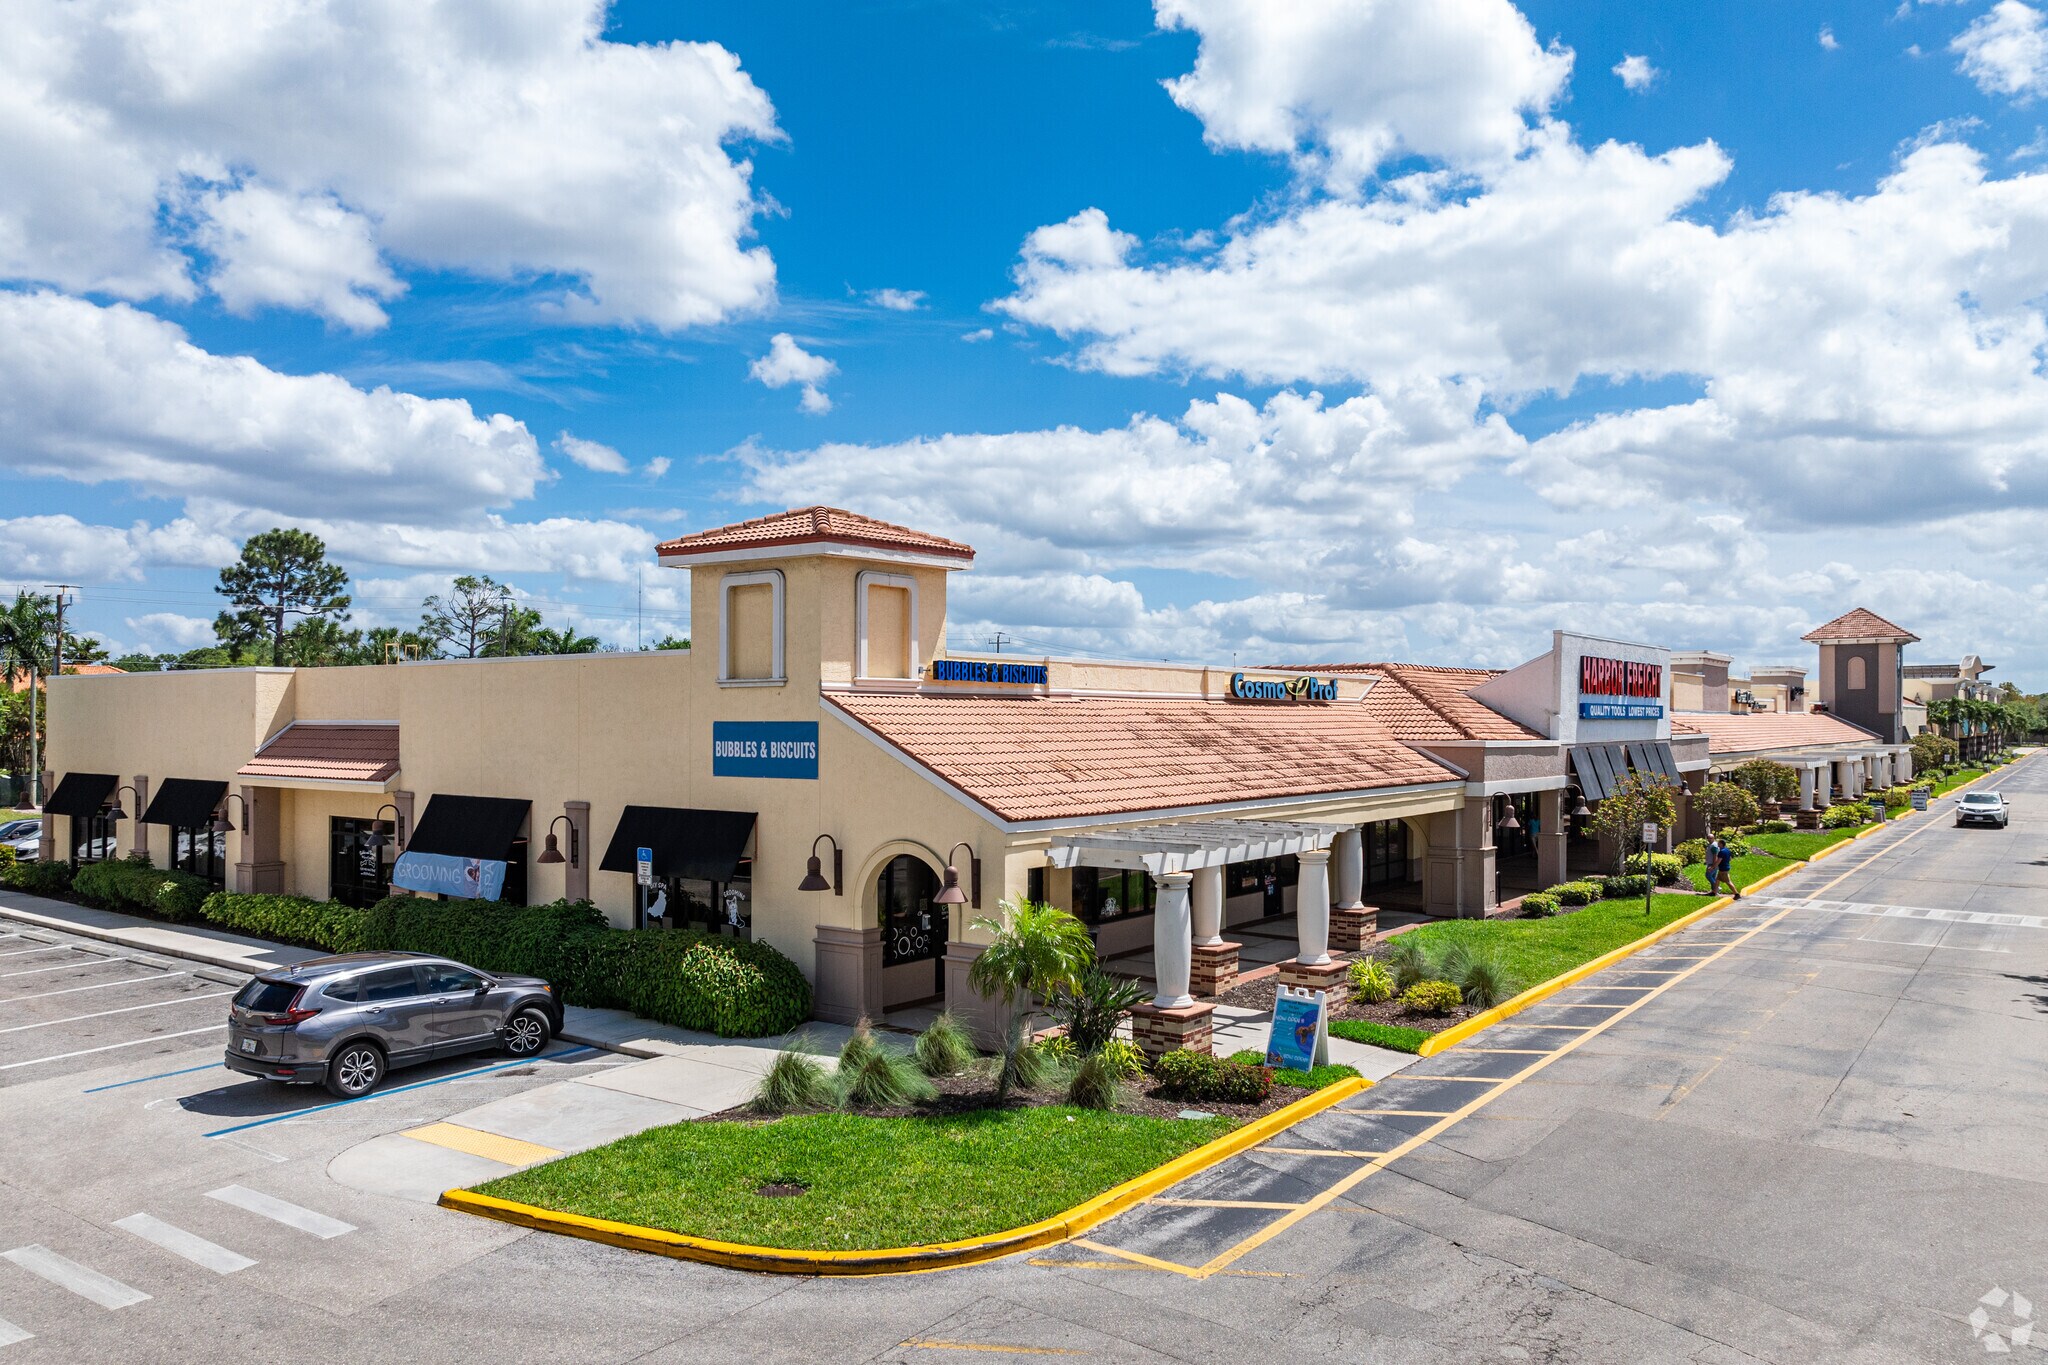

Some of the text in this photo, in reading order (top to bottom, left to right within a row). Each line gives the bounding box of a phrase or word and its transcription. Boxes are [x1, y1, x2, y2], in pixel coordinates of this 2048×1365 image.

[937, 660, 1048, 685] BUBBLES & BISCUITS
[1583, 656, 1662, 698] HARBOR FREIGHT
[1233, 672, 1338, 700] Cosmo Prof
[1590, 705, 1660, 717] QUALITY TOOLS LOWEST PRICES
[715, 741, 816, 760] BUBBLES & BISCUITS
[397, 862, 462, 884] GROOMING
[723, 889, 746, 901] GROOMING
